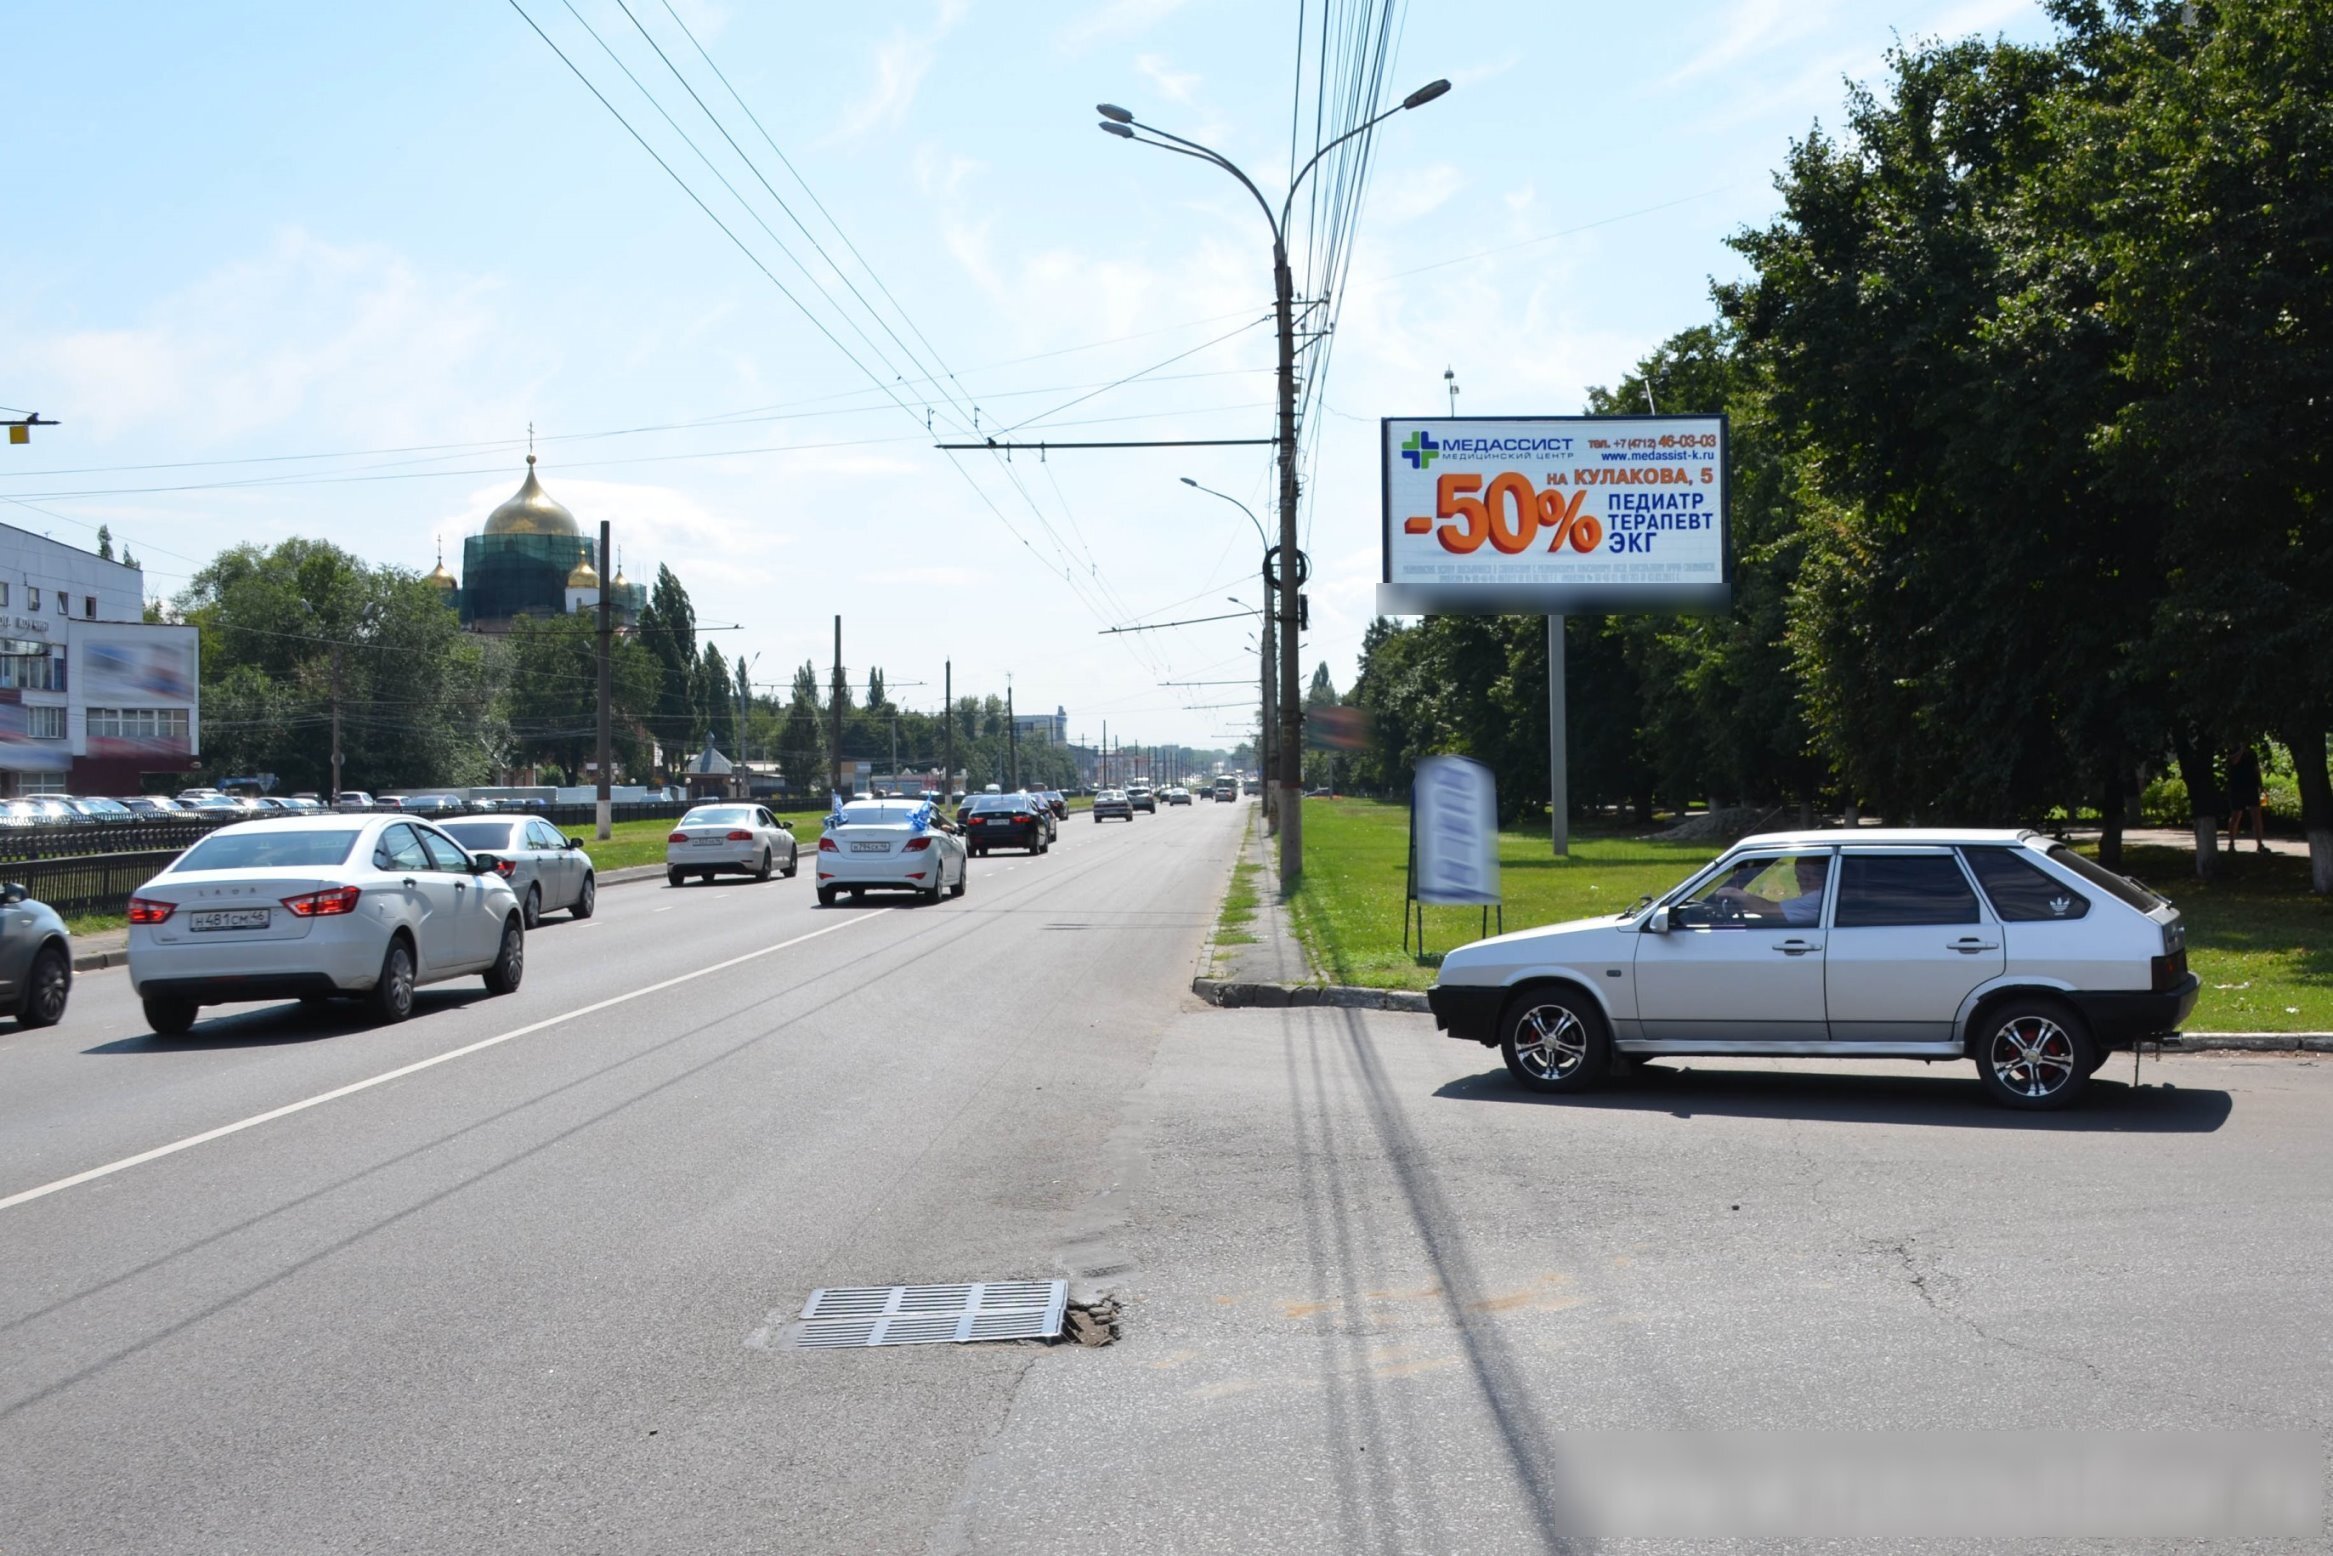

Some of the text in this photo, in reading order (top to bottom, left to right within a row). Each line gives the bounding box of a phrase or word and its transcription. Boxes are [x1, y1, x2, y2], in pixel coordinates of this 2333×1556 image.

[1443, 439, 1573, 452] МЕДАССИСТ
[1658, 435, 1717, 448] 46-03-03
[1443, 452, 1574, 460] МЕДИЦИНСКИЙ ЦЕНТР
[1601, 450, 1715, 461] www.medassist-k.ru
[1547, 467, 1714, 487] НА КУЛАКОВА, 5
[1608, 493, 1704, 514] ПЕДИАТР
[1404, 471, 1603, 555] -50%
[1608, 512, 1714, 531] ТЕРАПЕВТ
[1608, 532, 1657, 554] ЭКГ
[199, 887, 256, 897] LADA
